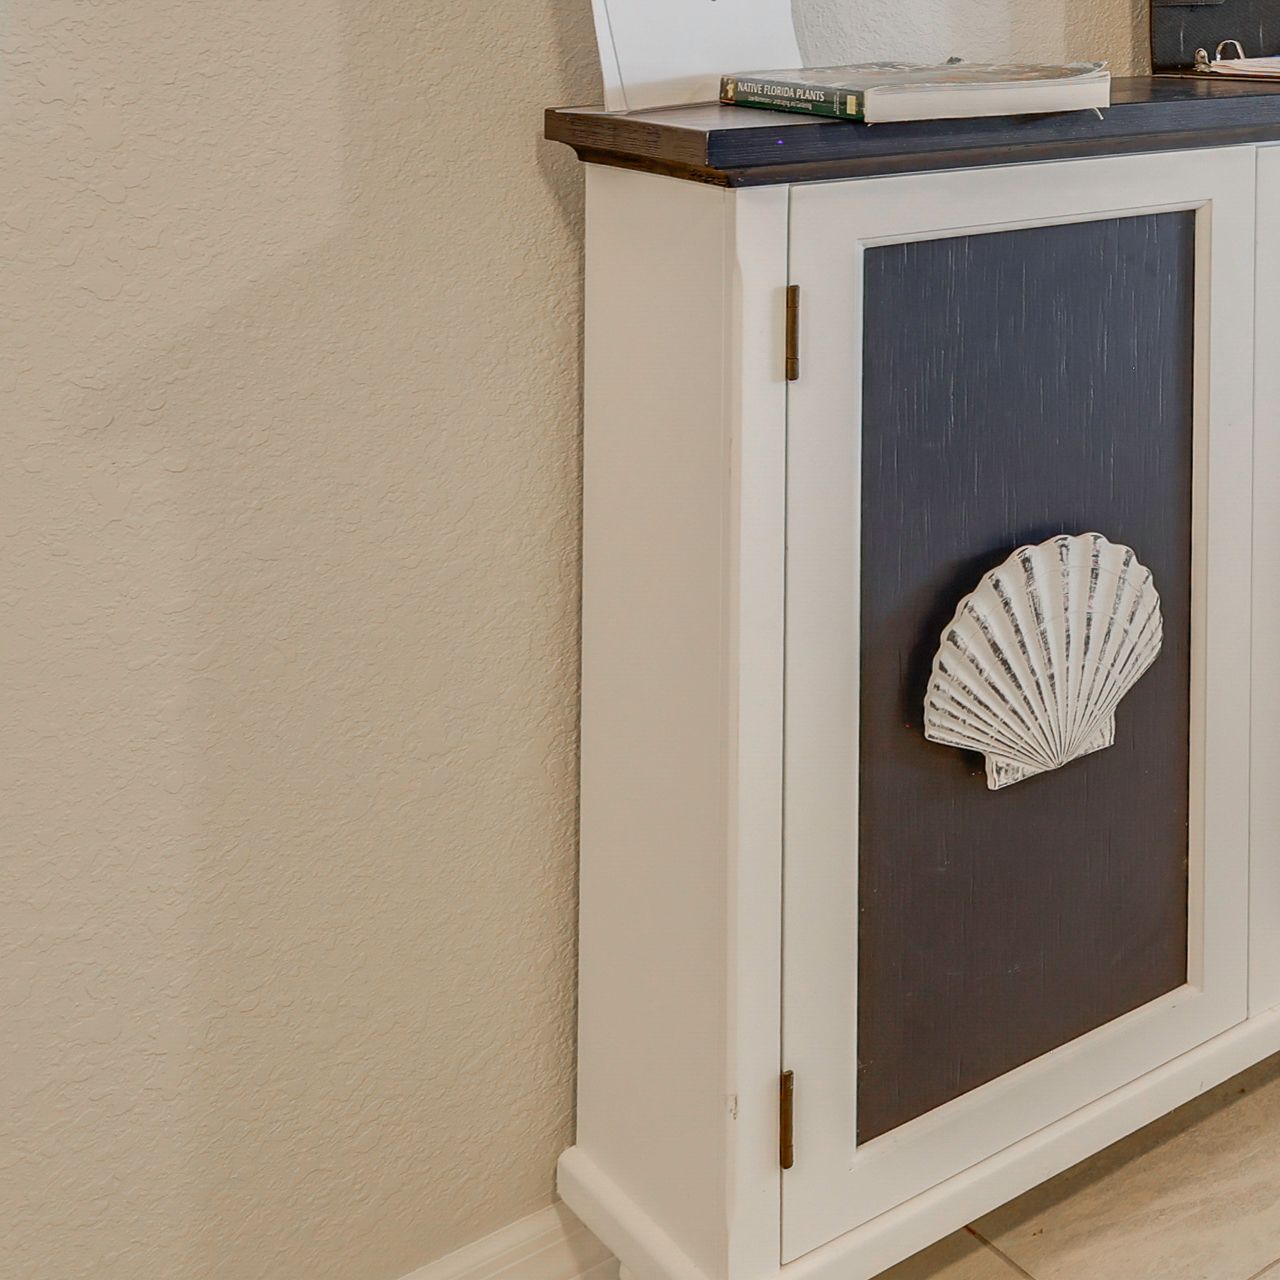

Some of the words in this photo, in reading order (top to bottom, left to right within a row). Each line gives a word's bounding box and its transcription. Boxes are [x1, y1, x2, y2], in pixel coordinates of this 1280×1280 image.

[737, 82, 763, 94] NATIVE
[763, 84, 795, 98] FLORIDA
[796, 88, 825, 102] PLANTS
